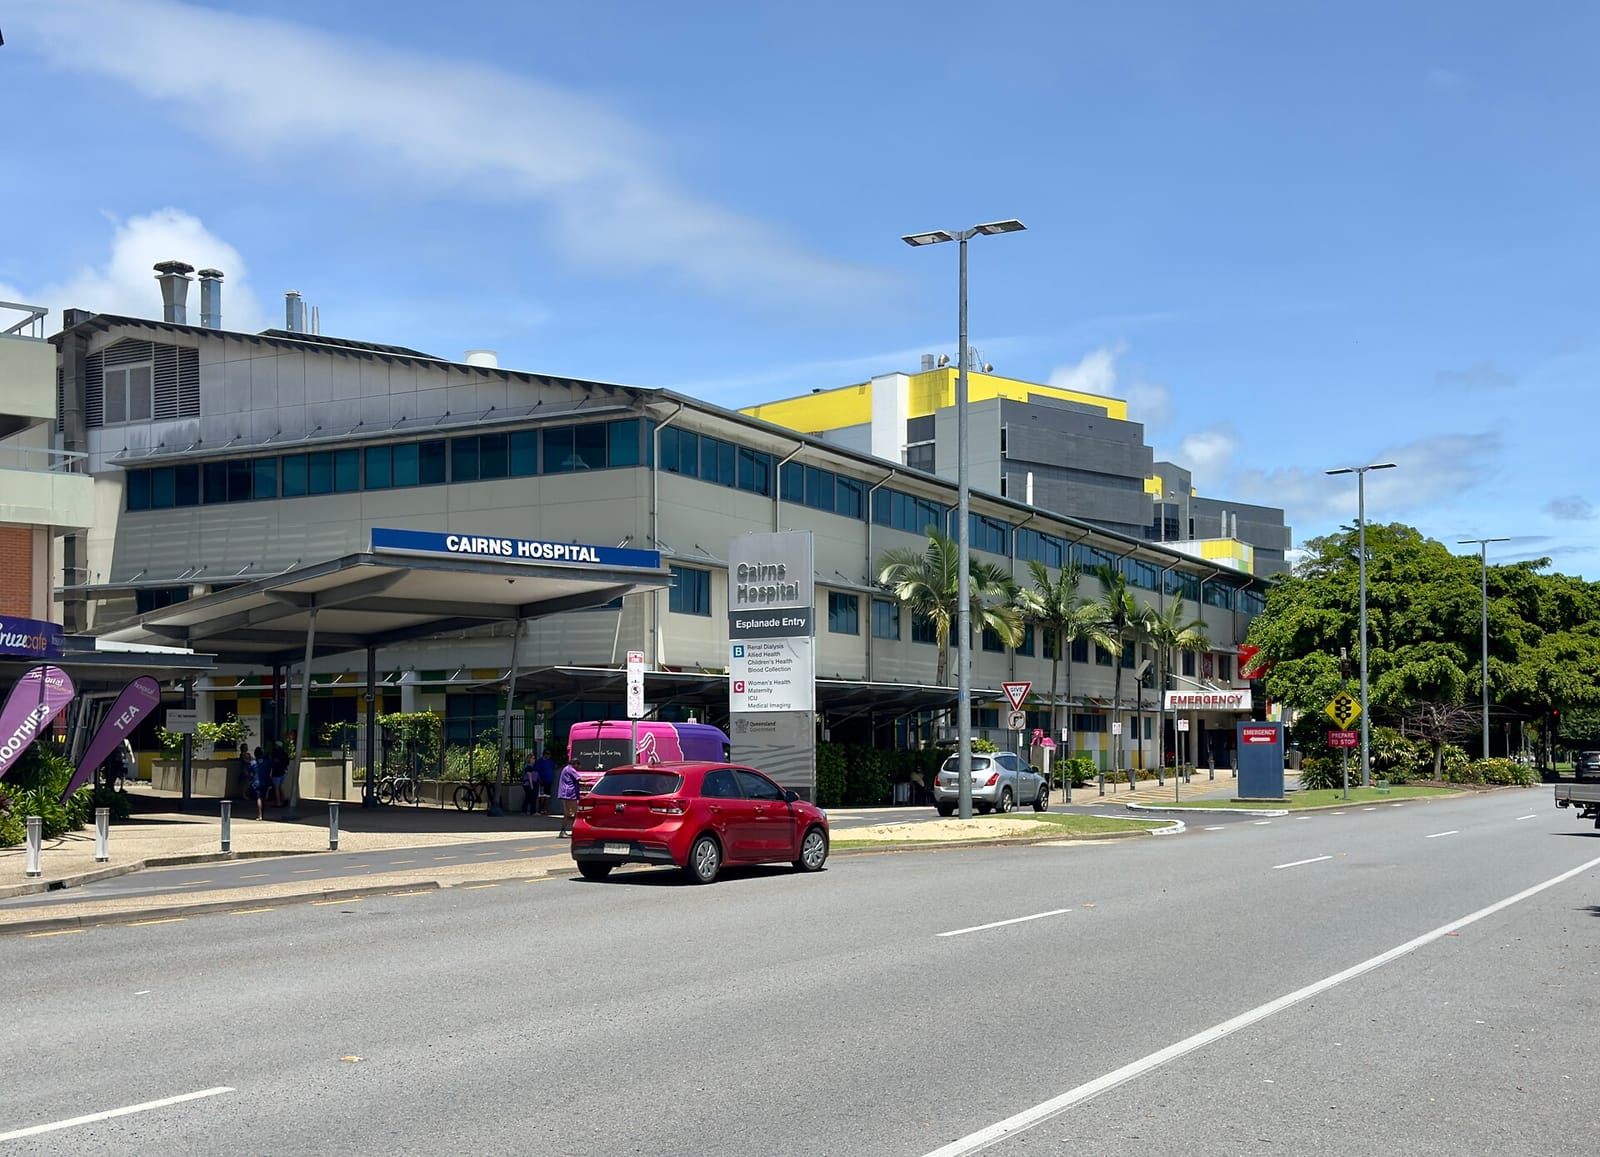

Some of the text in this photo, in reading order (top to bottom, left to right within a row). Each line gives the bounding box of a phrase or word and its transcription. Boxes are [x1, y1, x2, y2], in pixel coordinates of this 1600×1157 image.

[446, 536, 600, 562] CAIRNS HOSPITAL
[737, 562, 786, 582] Cairns
[737, 580, 799, 604] Hospital
[735, 617, 806, 629] Esplanade Entry
[735, 647, 743, 655] B
[735, 682, 744, 692] C
[1170, 695, 1243, 705] EMERGENCY
[113, 705, 140, 731] TEA
